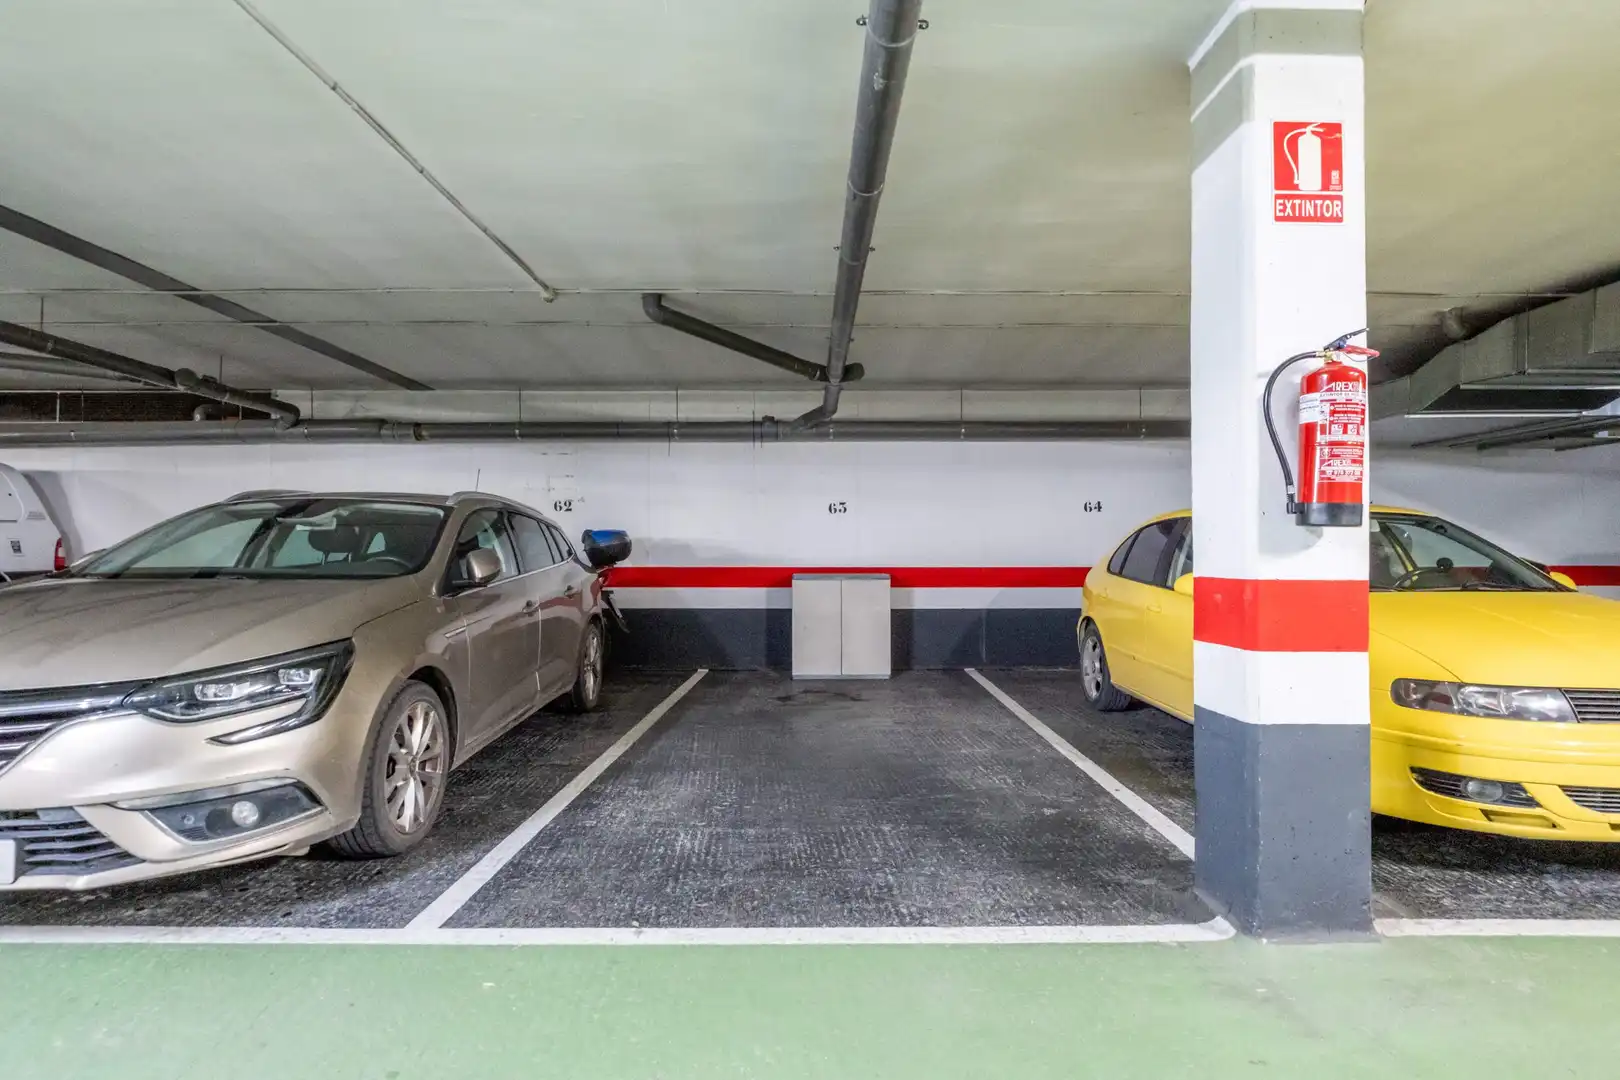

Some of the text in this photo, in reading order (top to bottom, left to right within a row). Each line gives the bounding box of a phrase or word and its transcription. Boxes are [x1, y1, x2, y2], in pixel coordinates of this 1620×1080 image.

[1276, 199, 1342, 217] EXTINTOR
[553, 500, 573, 512] 62
[1084, 501, 1103, 513] 64
